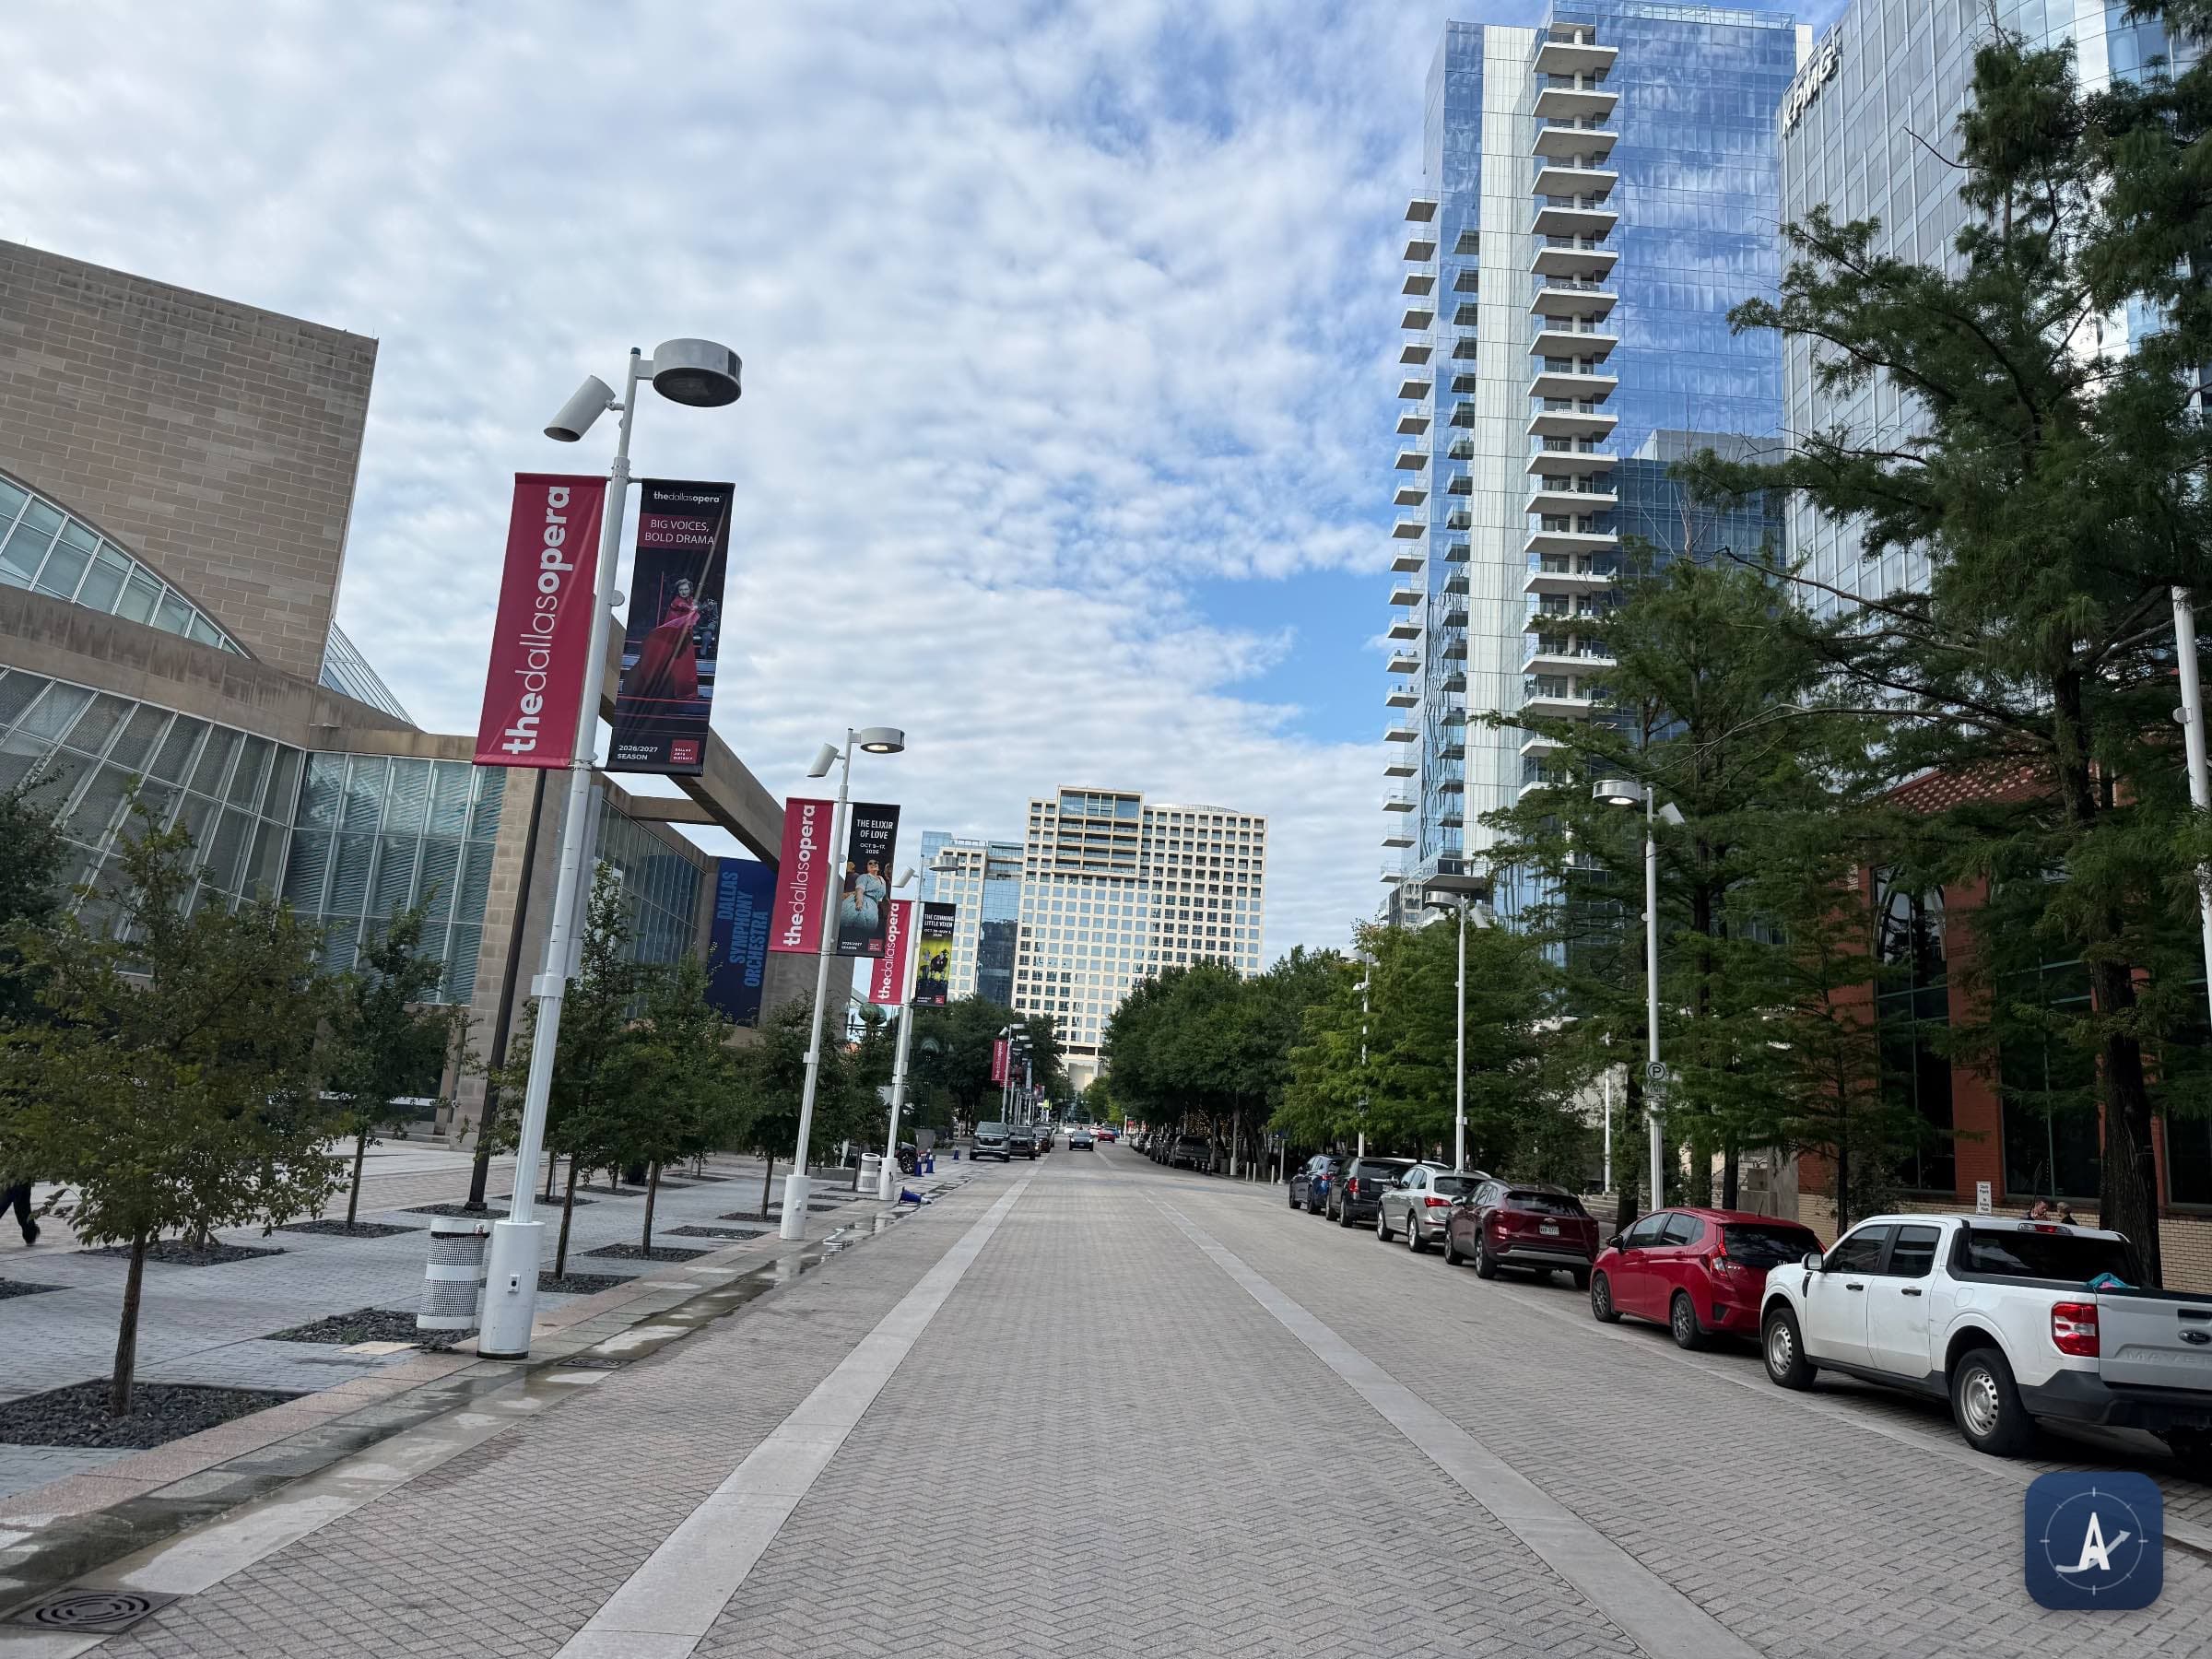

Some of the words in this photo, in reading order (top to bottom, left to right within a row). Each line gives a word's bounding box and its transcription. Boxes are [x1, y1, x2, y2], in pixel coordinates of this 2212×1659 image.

[1783, 45, 1837, 135] KPMG
[645, 532, 674, 543] BOLD
[676, 535, 714, 545] DRAMA
[651, 519, 668, 529] BIG
[670, 521, 710, 533] VOICES,
[502, 486, 573, 755] thedallasopera
[857, 818, 870, 828] THE
[871, 820, 893, 830] ELIXIR
[870, 830, 888, 840] LOVE
[717, 871, 738, 920] DALLAS
[783, 805, 818, 947] thedallasopera
[728, 890, 753, 964] SYMPHONY
[744, 911, 769, 987] ORCHESTRA
[877, 902, 901, 999] thedallasopera
[1653, 1066, 1662, 1077] P
